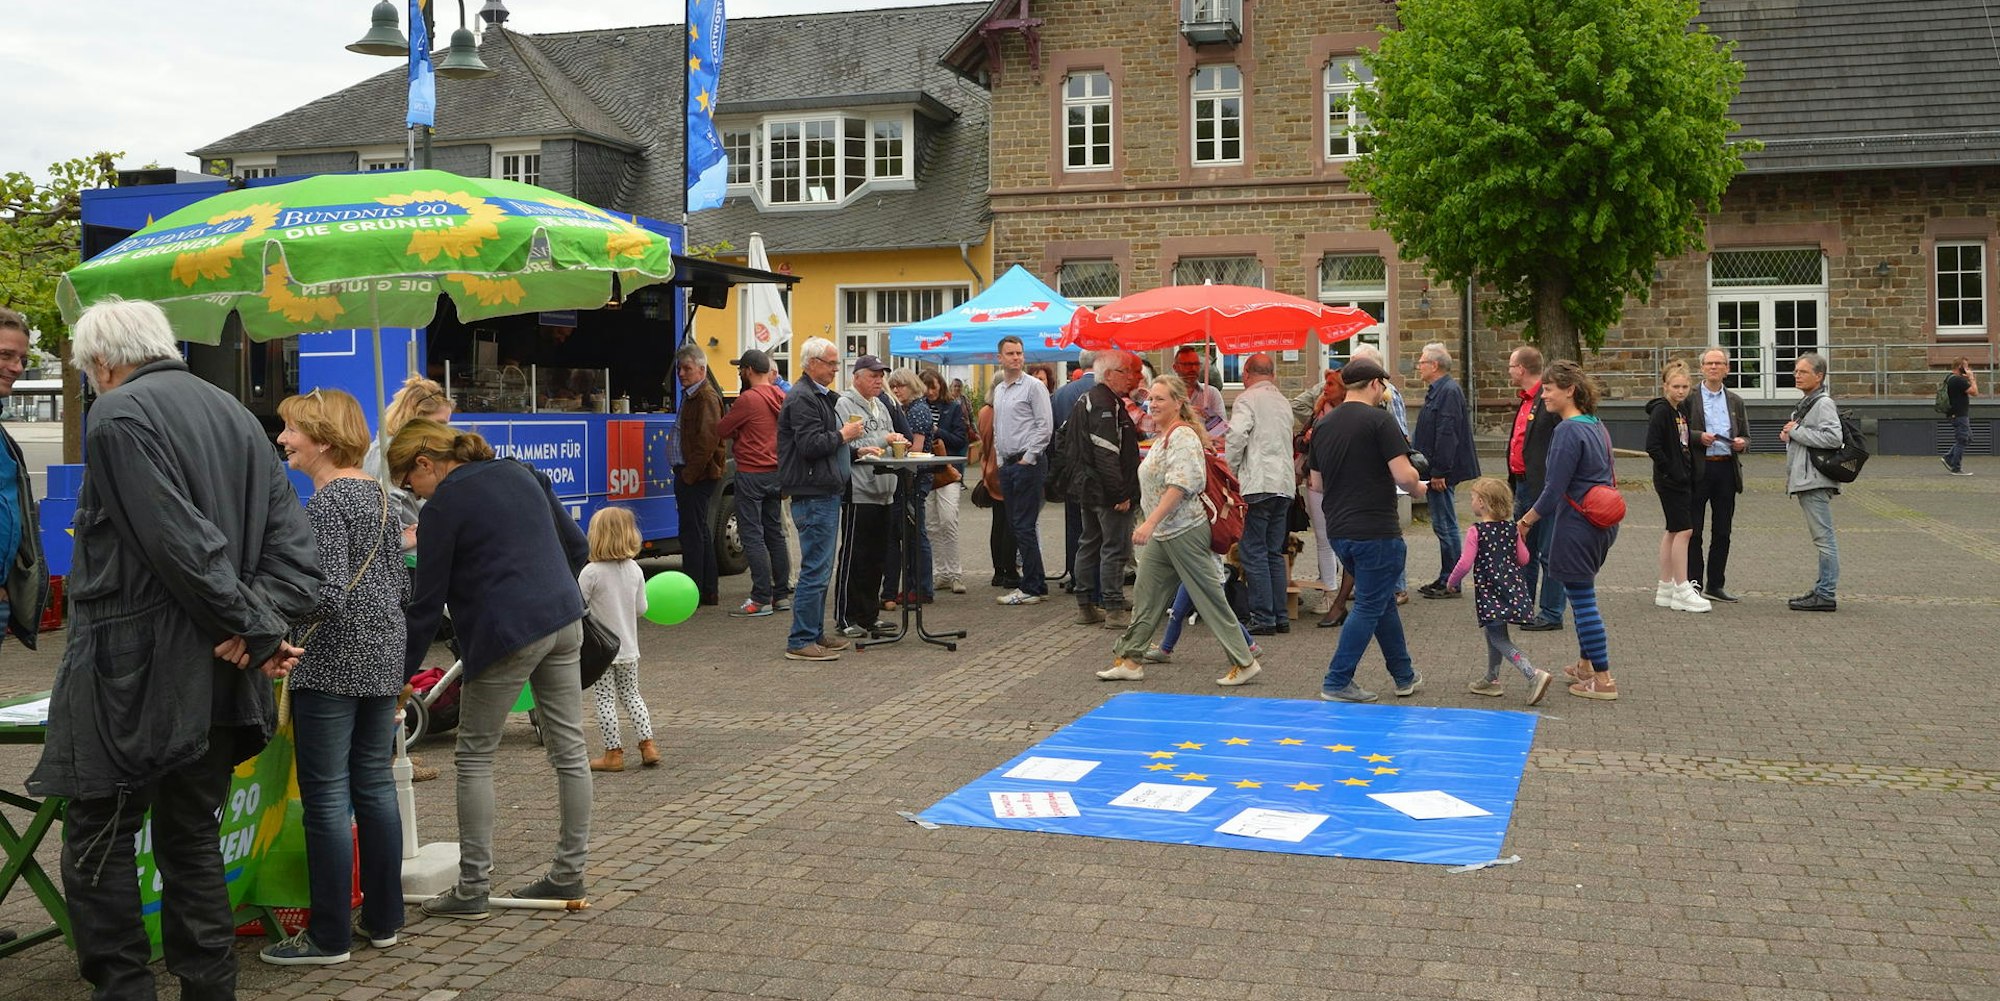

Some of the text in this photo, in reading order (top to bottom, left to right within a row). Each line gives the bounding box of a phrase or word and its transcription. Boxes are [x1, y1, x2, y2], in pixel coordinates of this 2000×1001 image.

[417, 203, 447, 216] 90
[286, 216, 455, 240] DIE GRÜNEN
[83, 236, 225, 271] DIE GRÜNEN
[494, 439, 582, 460] ZUSAMMEN FÜR
[542, 467, 575, 484] ROPA
[609, 469, 641, 495] SPD
[231, 783, 260, 823] 90
